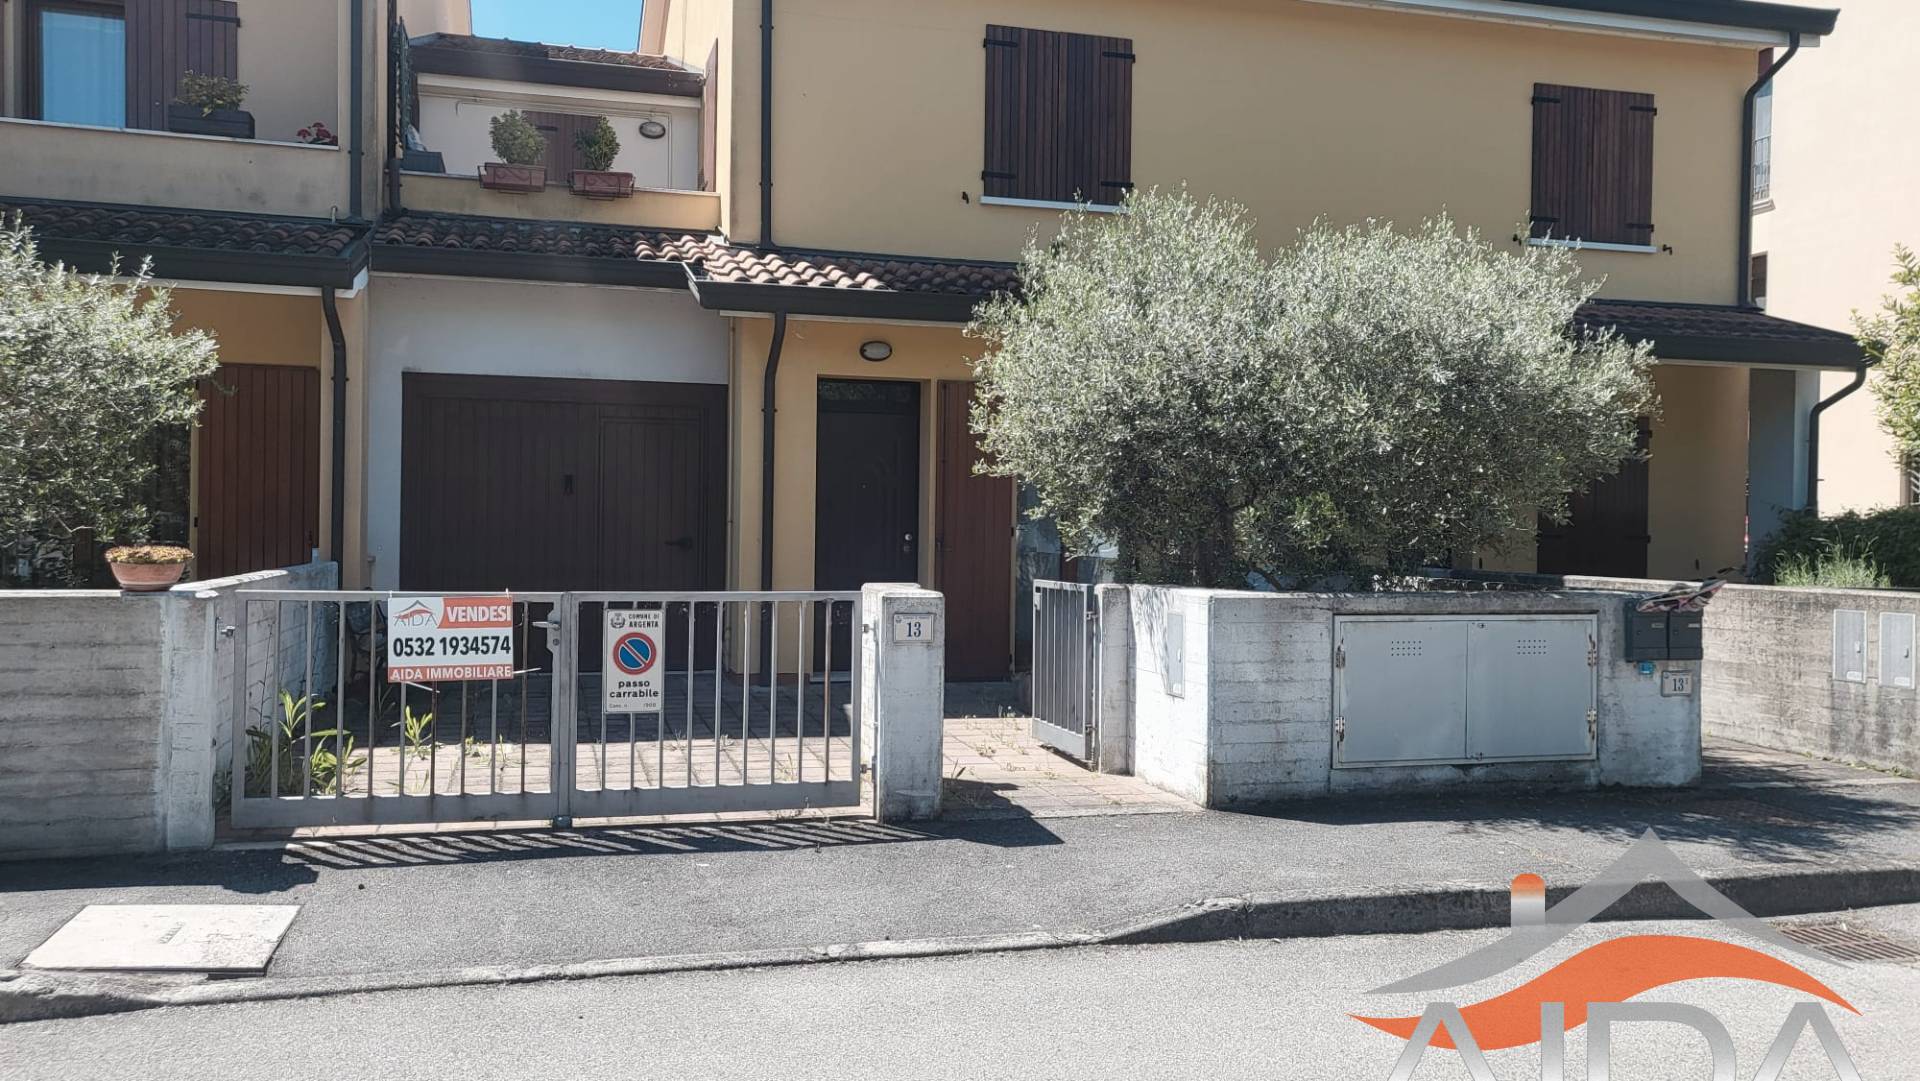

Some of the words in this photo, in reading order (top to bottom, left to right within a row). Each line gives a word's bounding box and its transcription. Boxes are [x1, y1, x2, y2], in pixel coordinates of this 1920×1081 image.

[394, 613, 438, 627] AIDA
[446, 605, 511, 623] VENDESI
[629, 620, 659, 628] ARGENTA
[907, 621, 921, 637] 13
[393, 636, 435, 657] 0532
[439, 635, 511, 656] 1934574
[390, 668, 423, 681] AIDA
[426, 665, 512, 680] IMMOBILIARE
[618, 680, 650, 689] passo
[609, 688, 659, 698] carrabile
